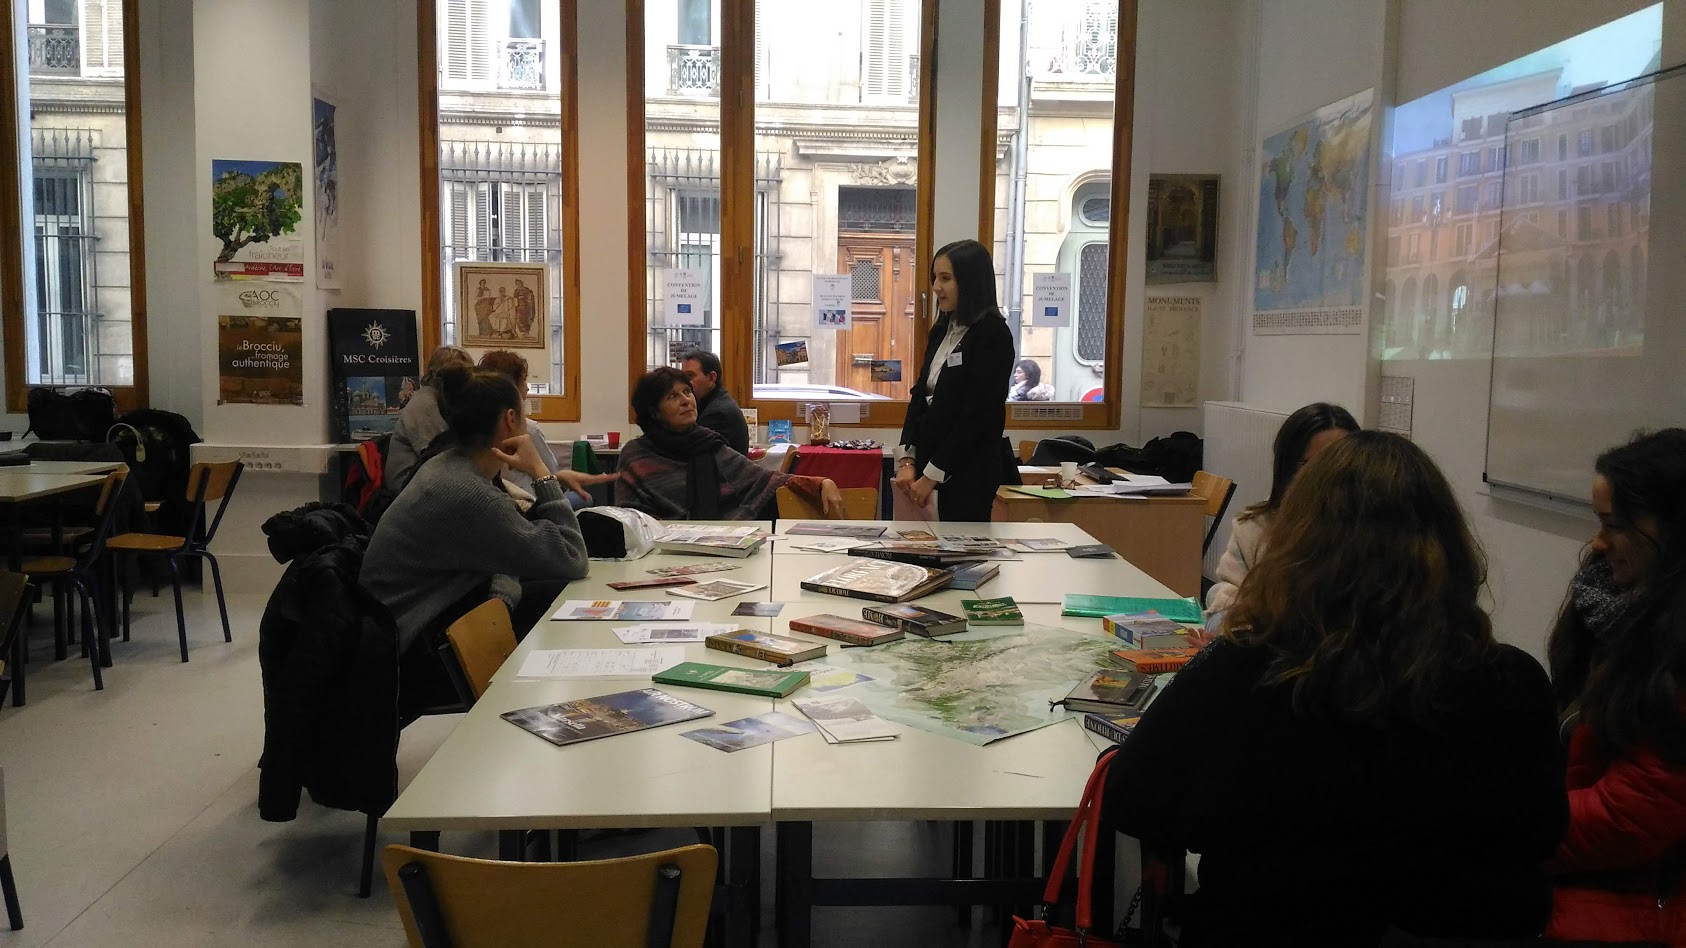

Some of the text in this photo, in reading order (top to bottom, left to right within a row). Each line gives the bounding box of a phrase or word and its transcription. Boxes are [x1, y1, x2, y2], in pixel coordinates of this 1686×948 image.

[252, 290, 280, 301] AOC
[1148, 297, 1200, 305] MONUMENTS
[243, 340, 285, 353] Brocciu,
[255, 351, 289, 362] fromage
[342, 354, 412, 364] MSC Croisières
[232, 357, 291, 371] authentique
